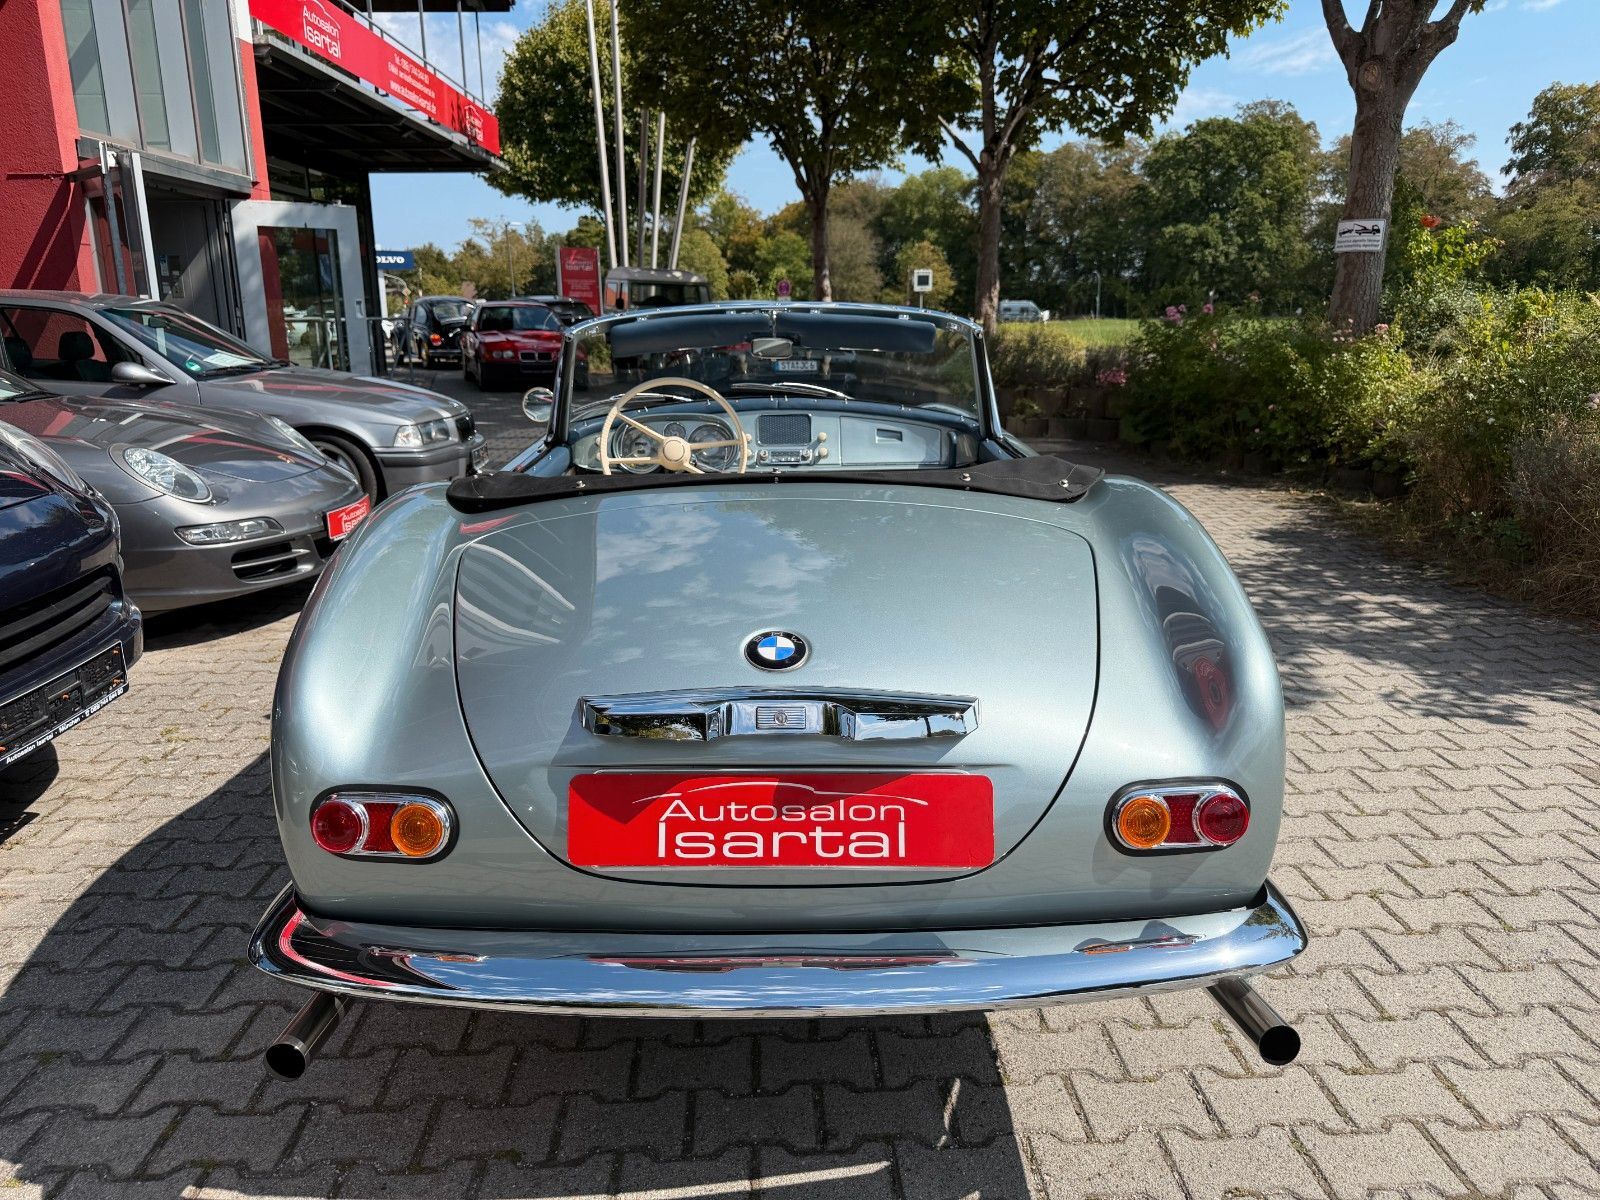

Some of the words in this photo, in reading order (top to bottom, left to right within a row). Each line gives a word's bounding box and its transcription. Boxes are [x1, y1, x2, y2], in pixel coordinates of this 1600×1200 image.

[303, 4, 340, 39] Autosalon
[303, 17, 342, 59] Isartal
[376, 255, 405, 264] OLVO
[659, 799, 905, 822] Autosalon
[658, 821, 906, 858] Isartal
